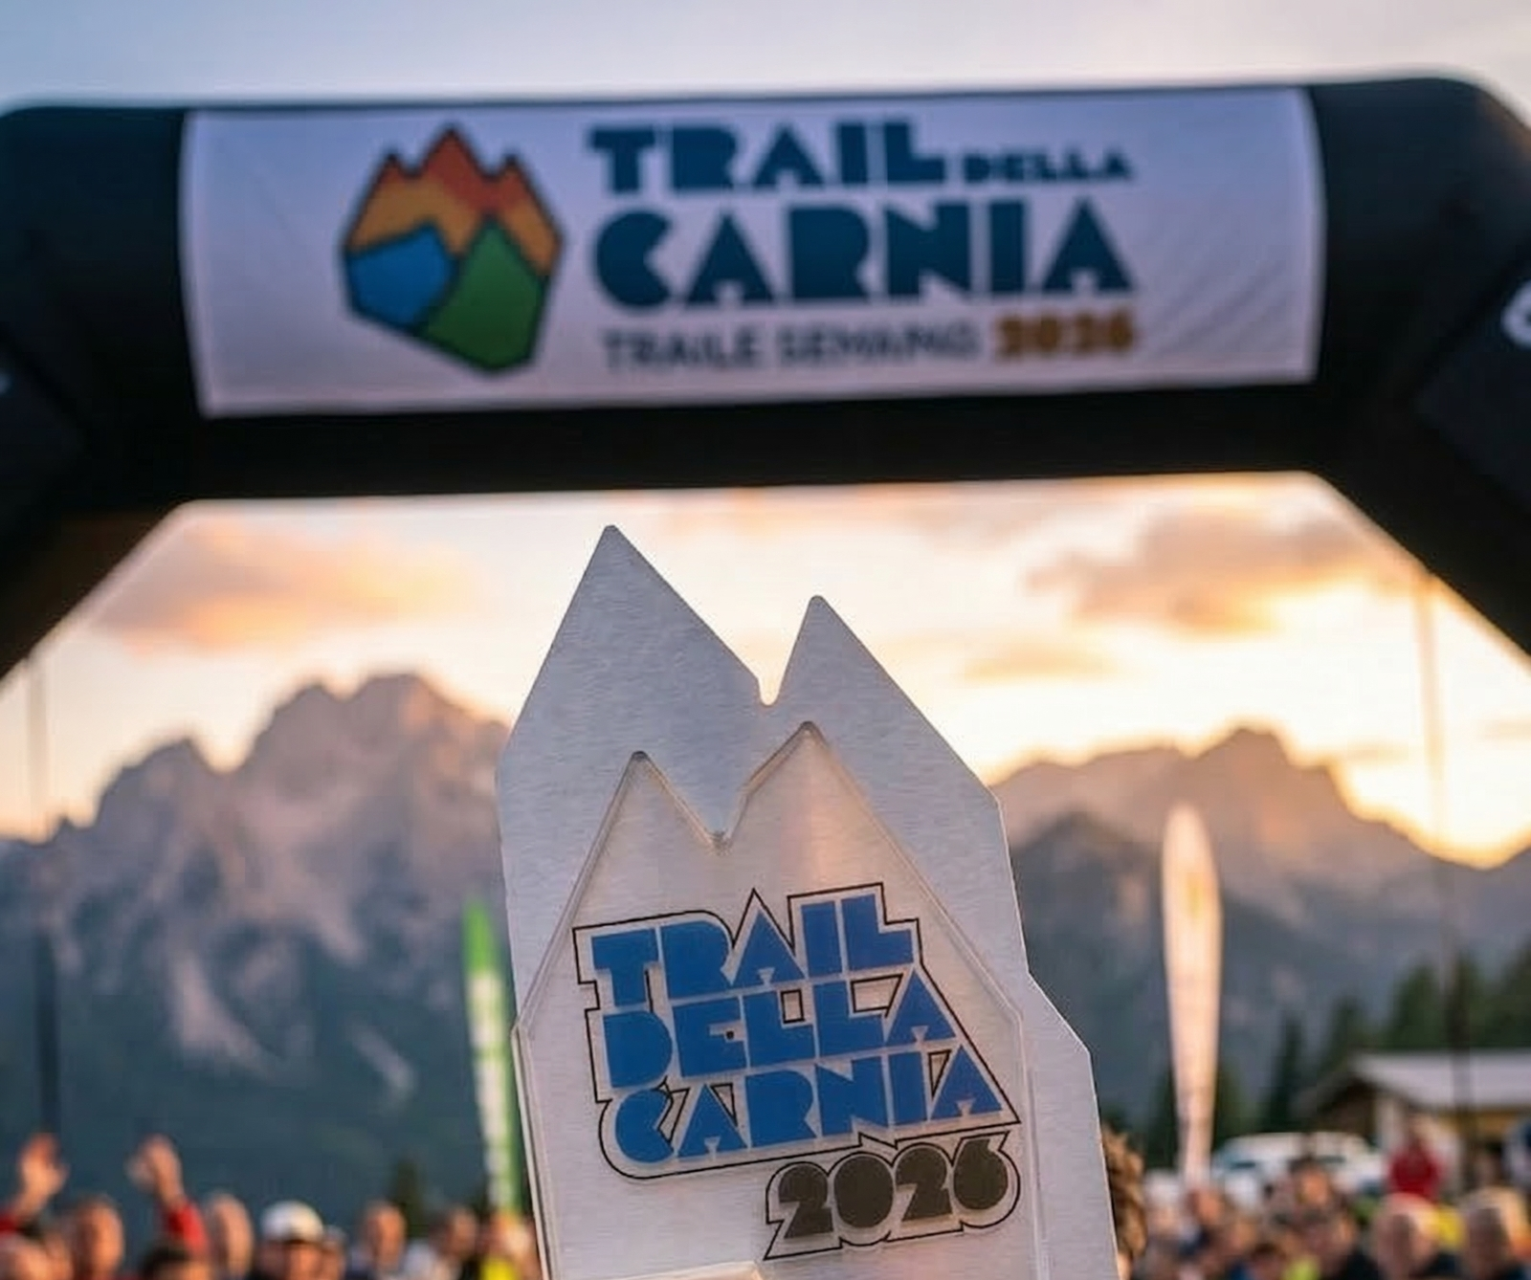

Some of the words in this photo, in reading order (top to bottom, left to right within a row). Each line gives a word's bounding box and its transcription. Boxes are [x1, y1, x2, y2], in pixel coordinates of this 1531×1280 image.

[588, 120, 947, 194] TRAIL
[961, 145, 1133, 184] DELLA
[593, 199, 1134, 313] CARNIA
[591, 893, 915, 1008] TRAIL
[602, 965, 957, 1089] DELLA
[614, 1045, 1004, 1164] CARNIA
[777, 1138, 1009, 1240] 2026
